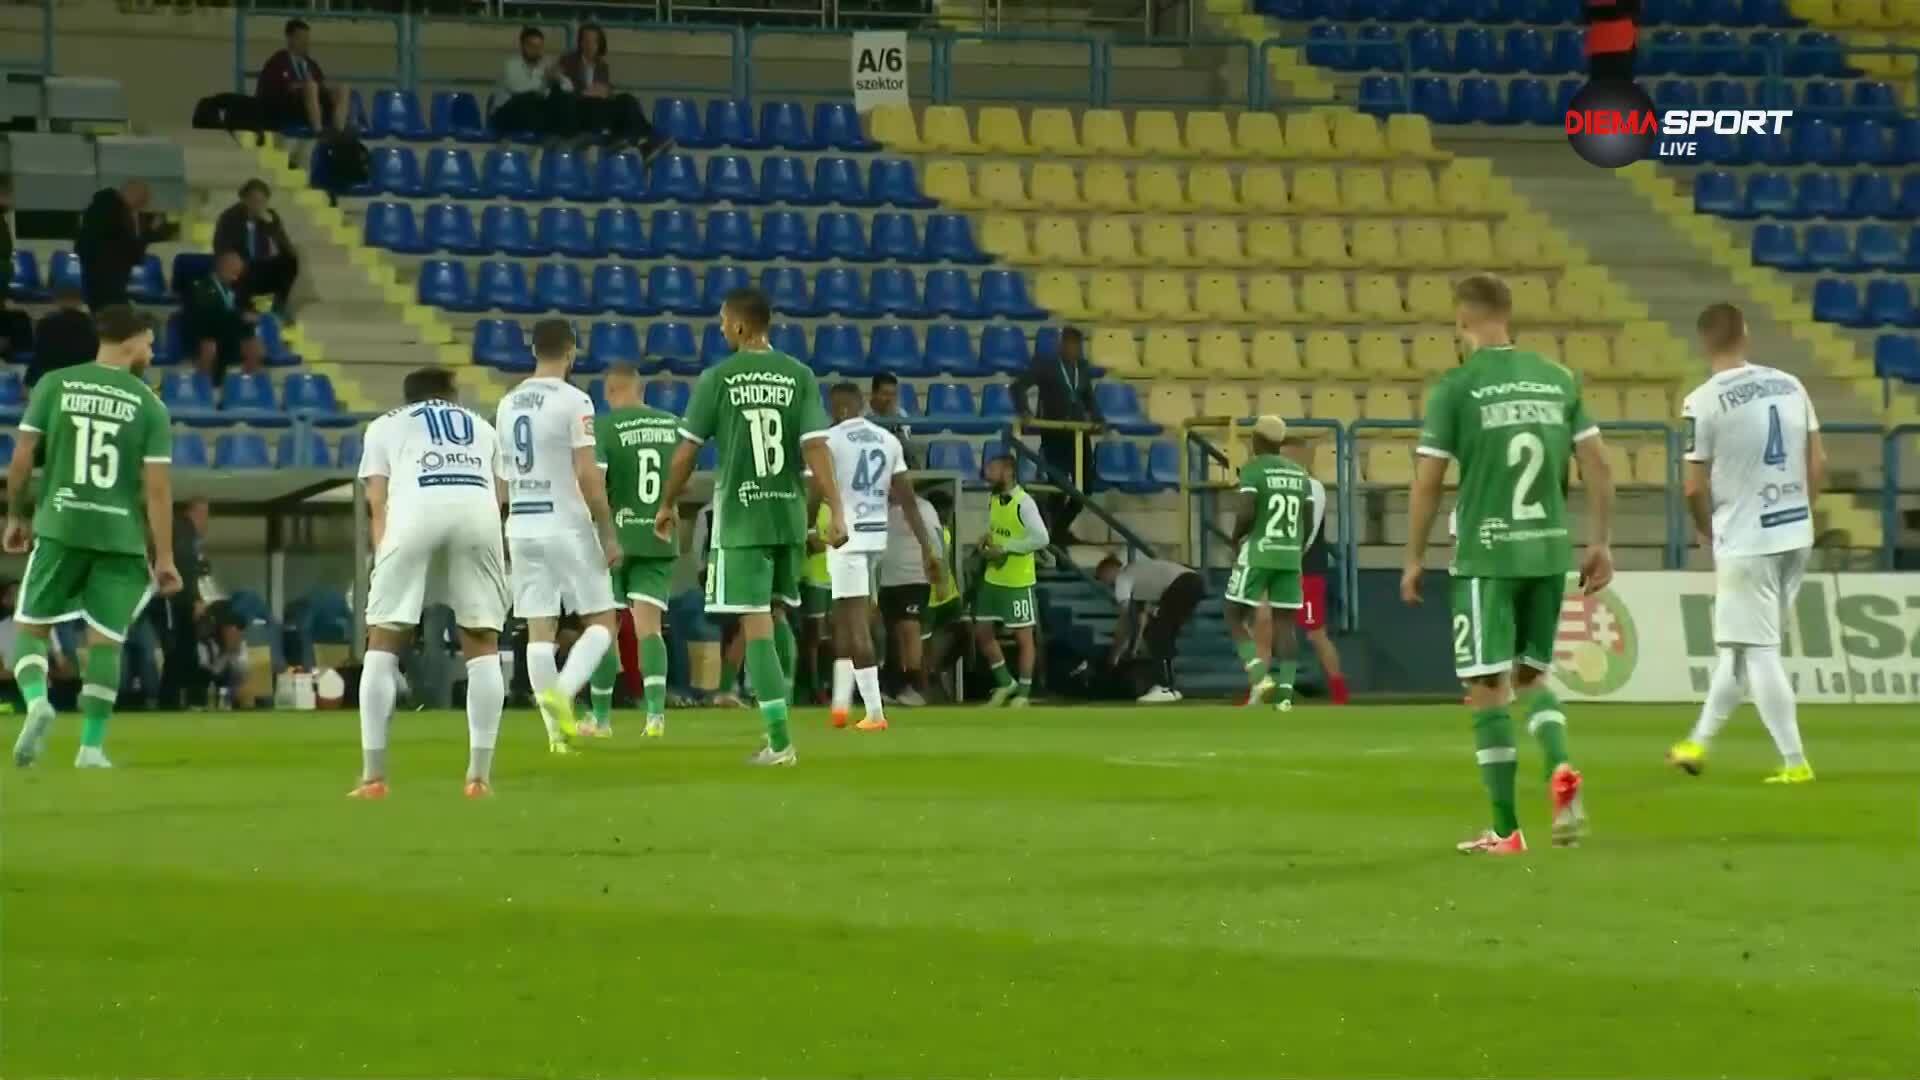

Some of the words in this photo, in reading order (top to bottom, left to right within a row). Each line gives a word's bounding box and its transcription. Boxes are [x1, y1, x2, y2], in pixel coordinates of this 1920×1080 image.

[856, 77, 904, 90] szektor
[857, 48, 903, 73] A/6
[723, 372, 796, 386] VIVACOM
[728, 385, 794, 407] CHOCHEV
[410, 407, 474, 446] 10
[513, 415, 534, 475] 9
[741, 408, 785, 478] 18
[1764, 404, 1787, 471] 4
[71, 415, 120, 489] 15
[852, 448, 887, 495] 42
[637, 448, 660, 504] 6
[1507, 431, 1547, 520] 2
[1265, 493, 1300, 539] 29
[1454, 614, 1470, 653] 2
